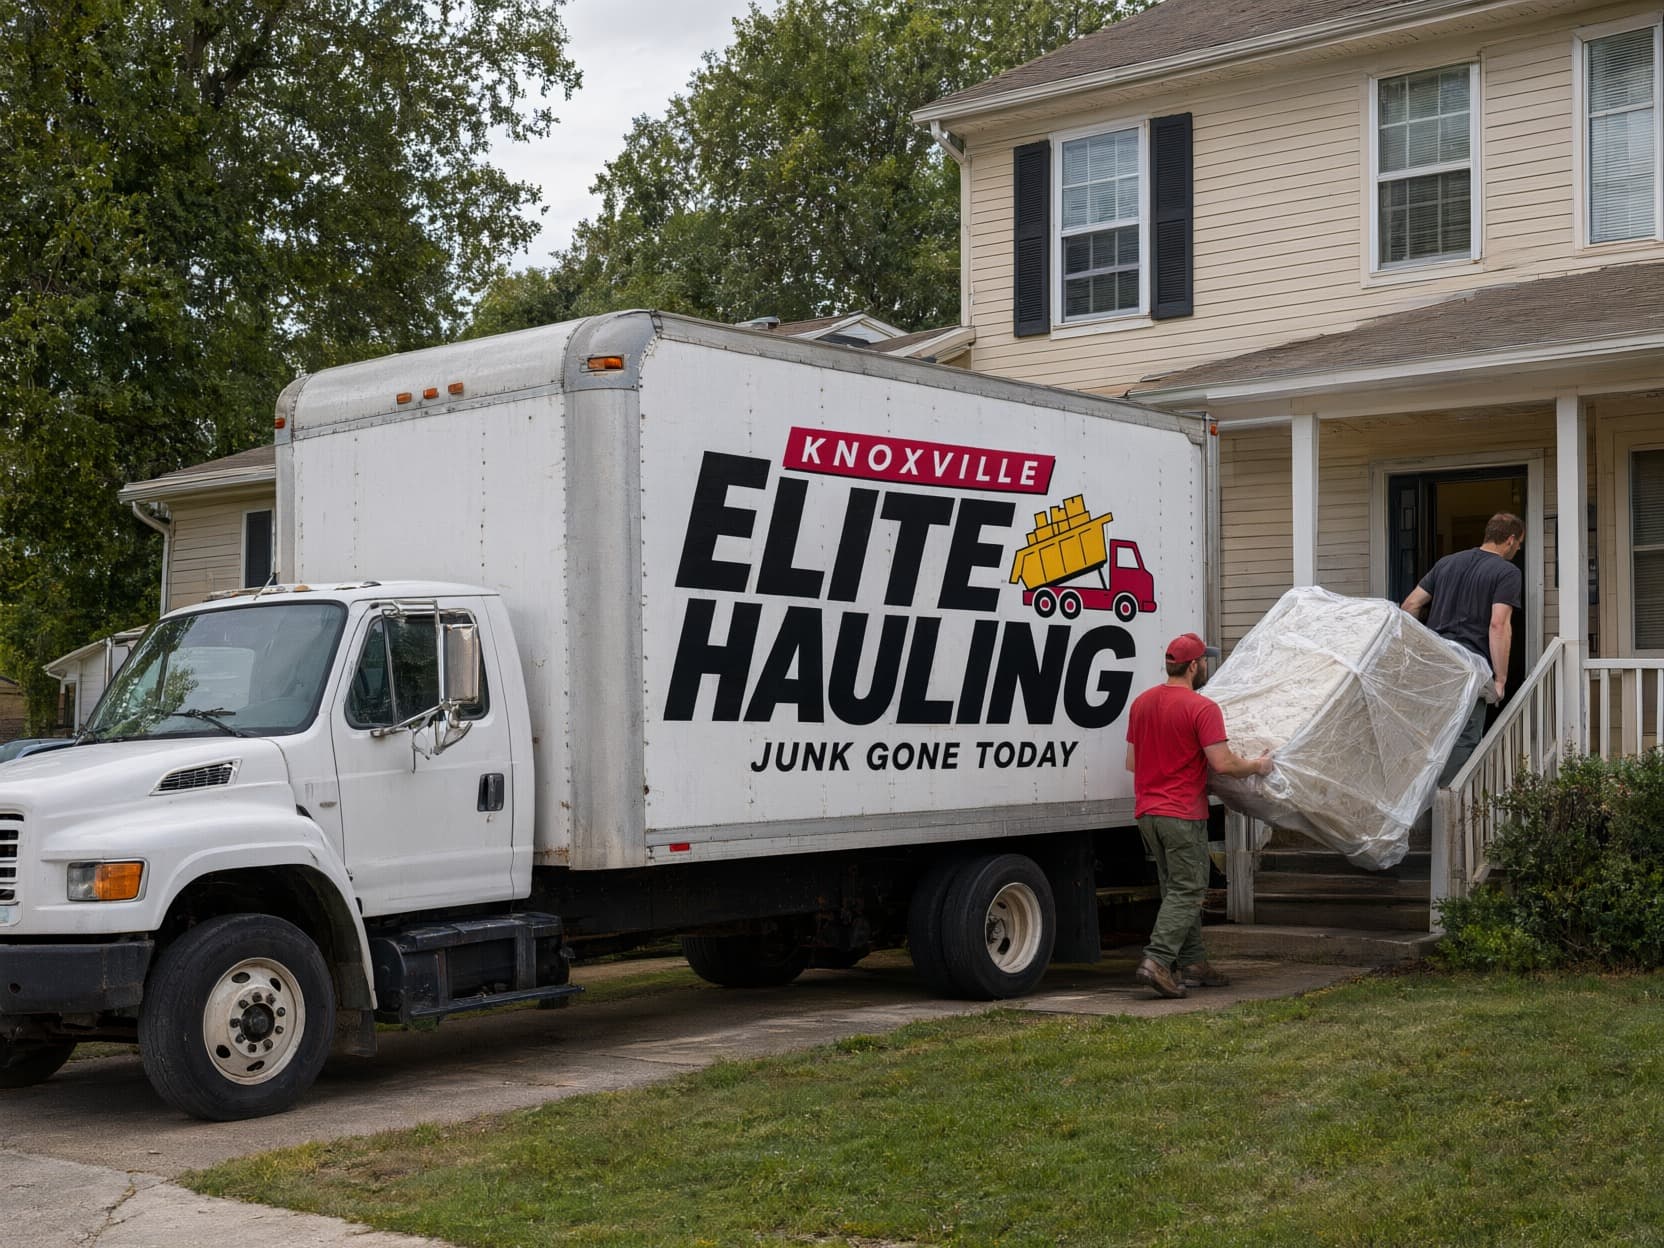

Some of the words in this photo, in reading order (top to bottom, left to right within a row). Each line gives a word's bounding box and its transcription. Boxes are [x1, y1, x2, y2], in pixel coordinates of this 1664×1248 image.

[800, 436, 1039, 486] KNOXVILLE
[674, 450, 1017, 613] ELITE
[663, 598, 1137, 729] HAULING
[750, 741, 855, 773] JUNK
[866, 742, 960, 771] GONE
[976, 741, 1079, 769] TODAY
